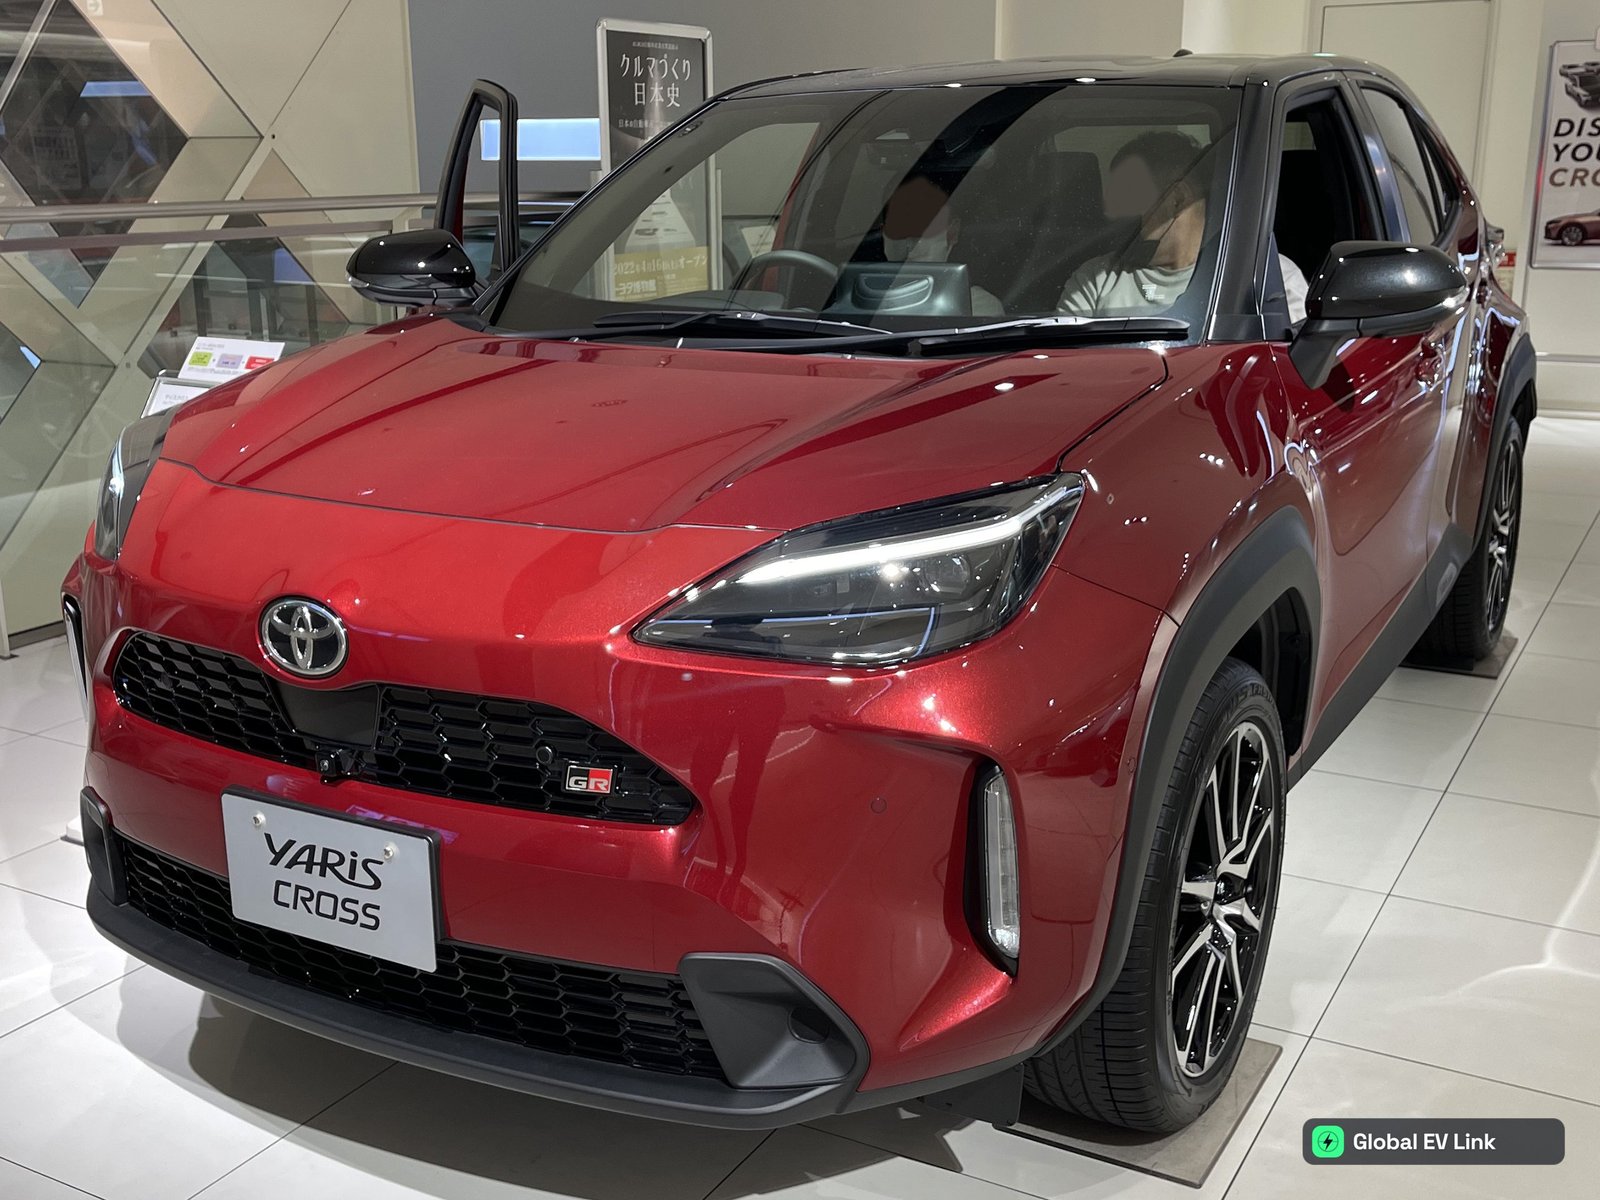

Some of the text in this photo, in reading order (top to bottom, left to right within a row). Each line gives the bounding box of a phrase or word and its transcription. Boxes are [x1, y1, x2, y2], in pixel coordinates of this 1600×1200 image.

[620, 53, 691, 80] クルマづくり
[634, 82, 681, 108] 日本史
[1553, 142, 1600, 162] YO
[568, 776, 609, 791] GR
[273, 879, 381, 931] CROSS
